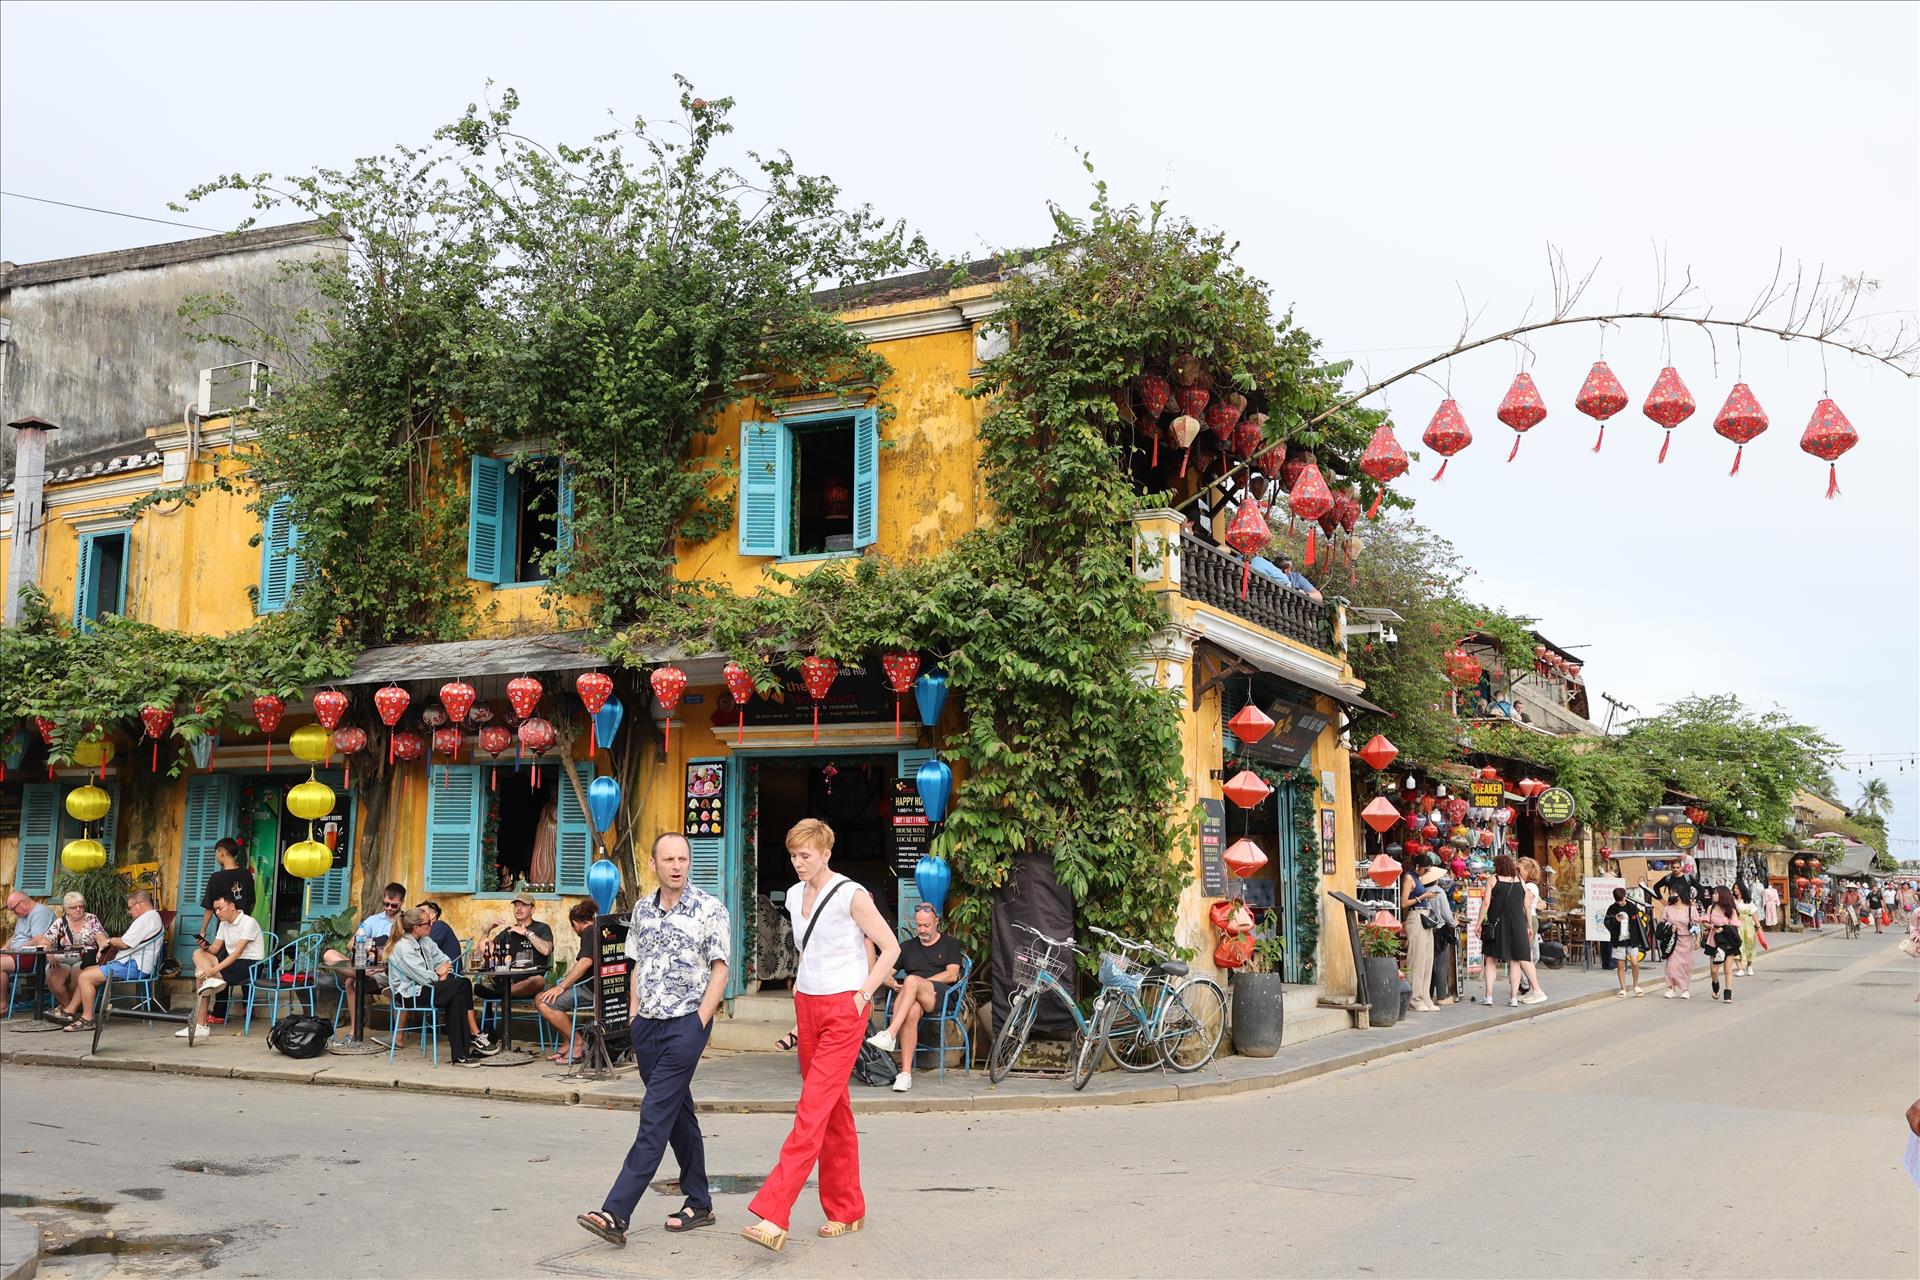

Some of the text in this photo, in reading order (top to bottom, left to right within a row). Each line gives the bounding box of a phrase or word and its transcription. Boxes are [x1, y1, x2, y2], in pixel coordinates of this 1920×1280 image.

[786, 680, 808, 692] the
[895, 796, 923, 807] HAPPY HO
[1475, 795, 1498, 807] SHOES
[916, 816, 926, 824] FREE
[602, 944, 616, 956] HAPPY
